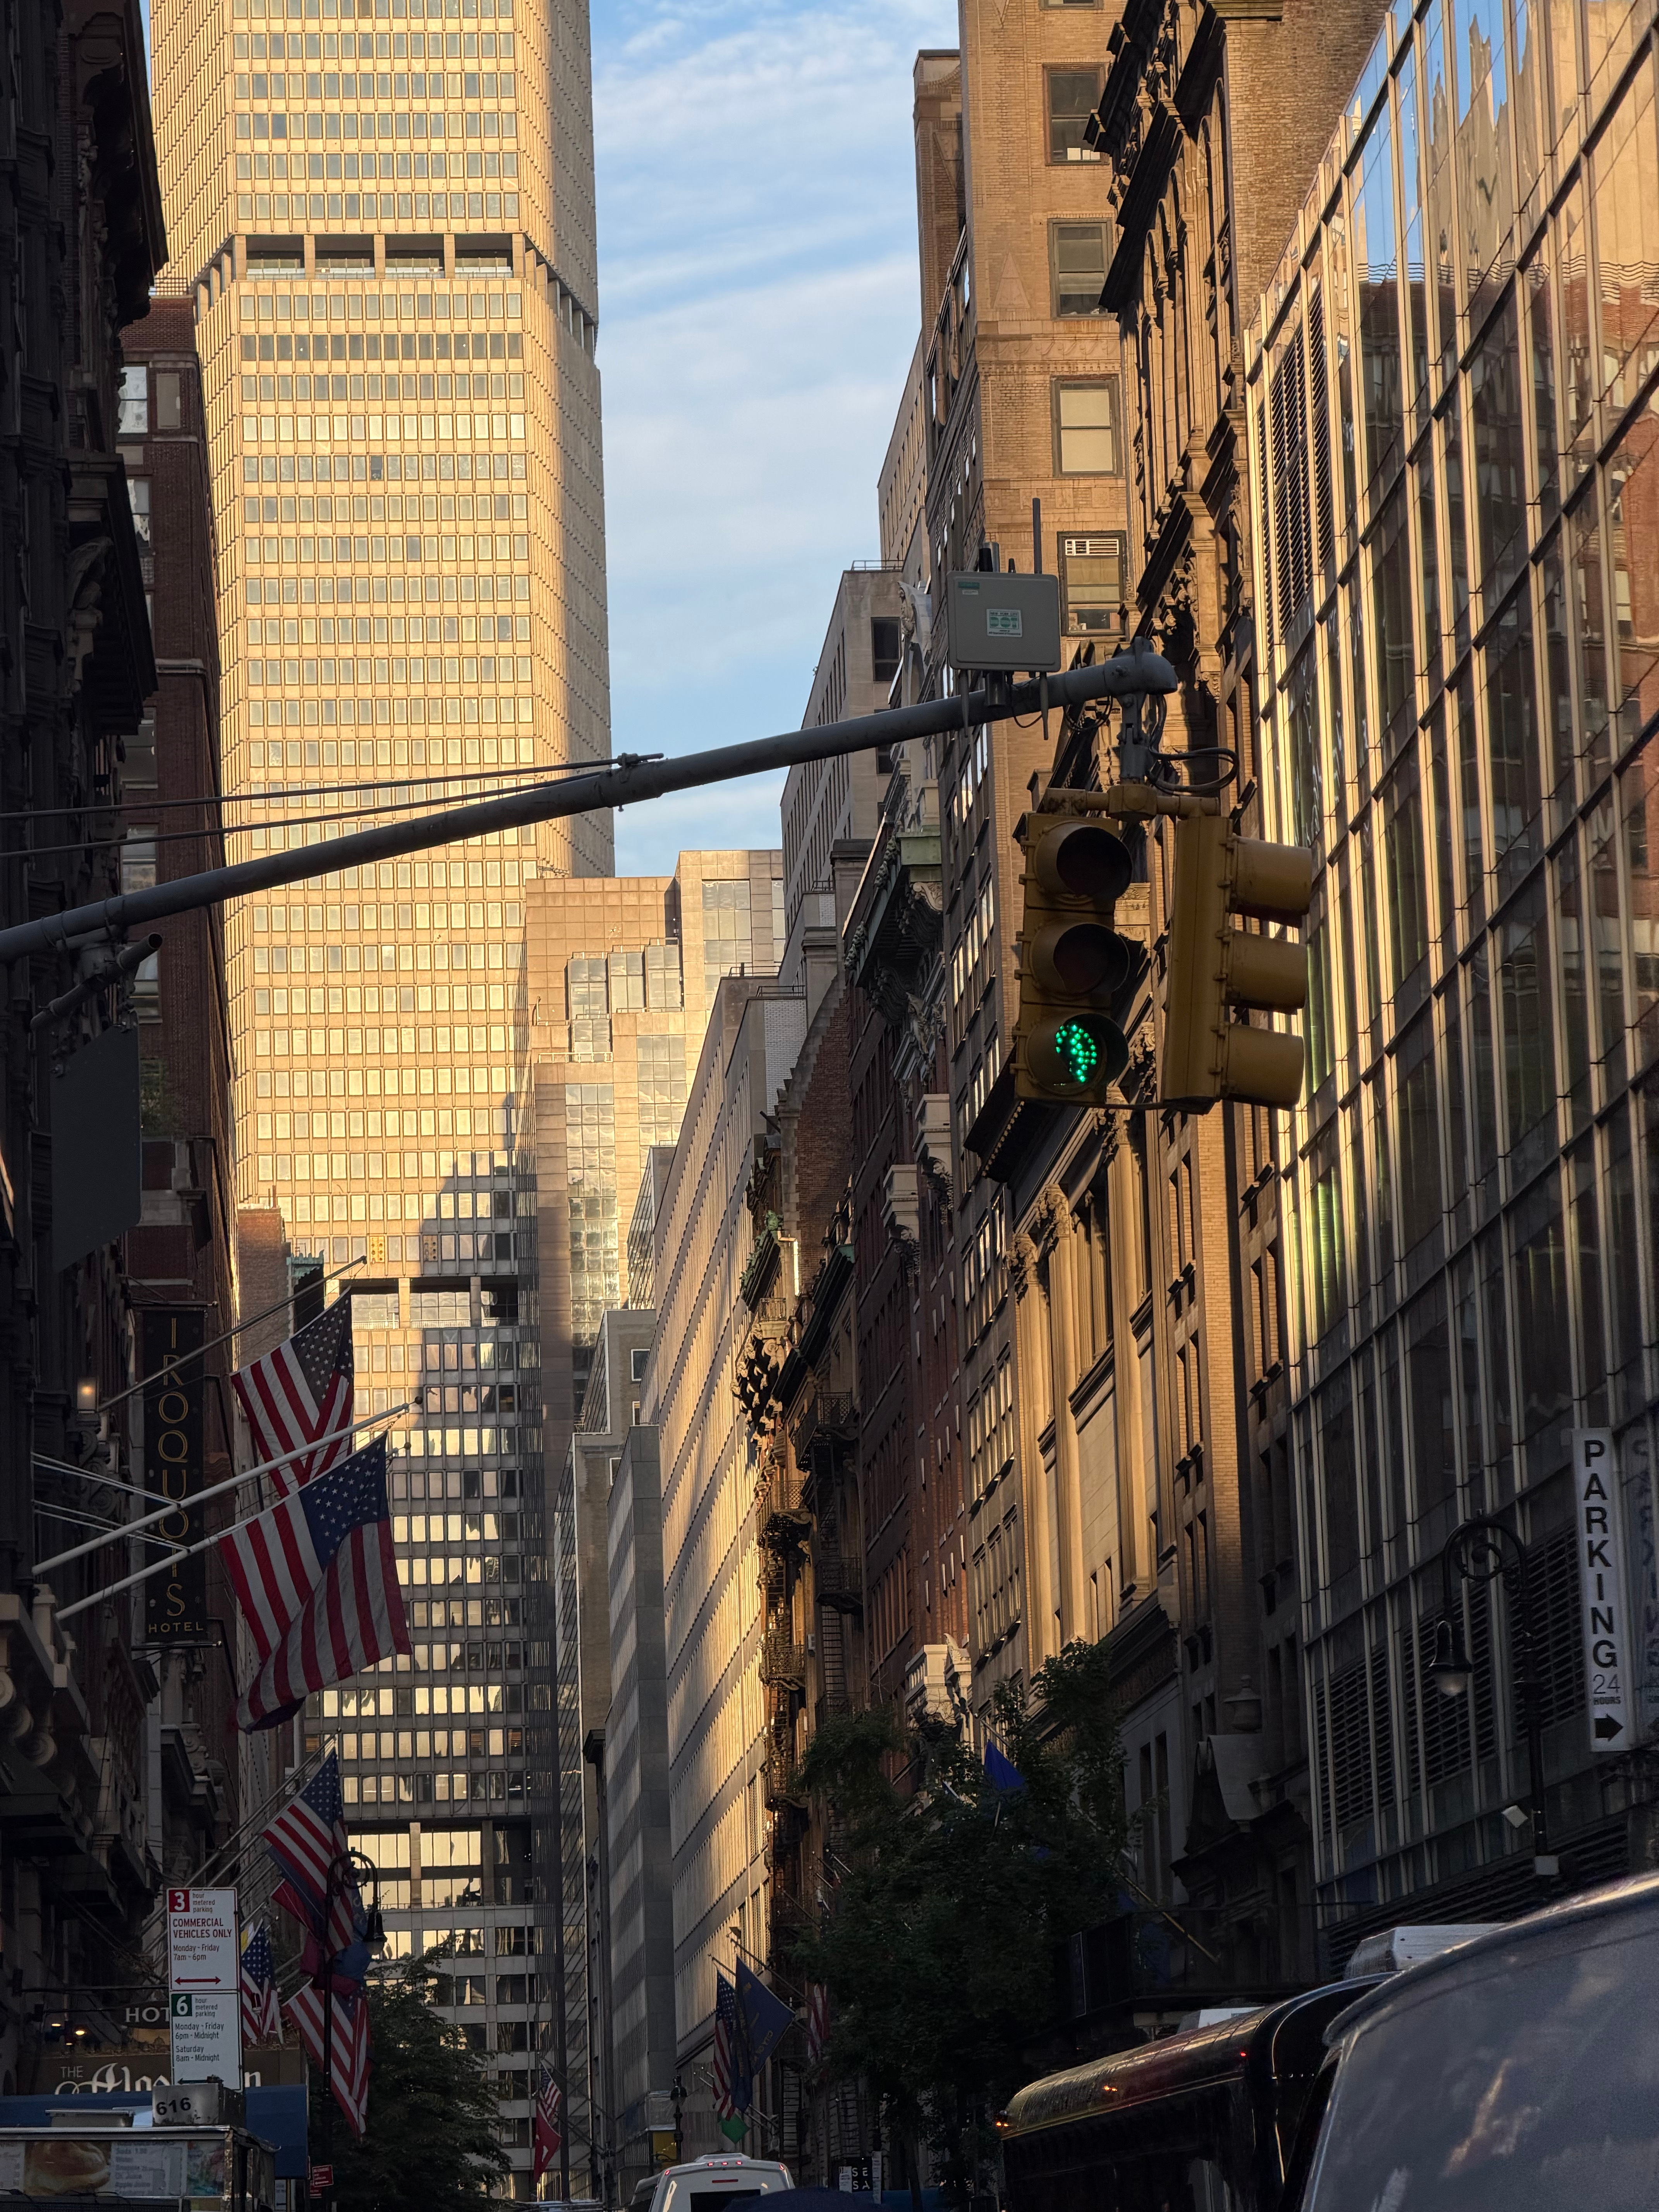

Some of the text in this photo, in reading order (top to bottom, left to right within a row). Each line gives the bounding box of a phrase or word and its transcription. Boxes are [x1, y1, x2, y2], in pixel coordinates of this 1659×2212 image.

[1583, 1439, 1618, 1668] PARKING
[149, 1621, 203, 1634] HOTEL
[1593, 1674, 1620, 1694] 24
[174, 1891, 185, 1911] 3
[173, 1918, 223, 1927] COMMERCIAL
[173, 1929, 232, 1938] VEHICLES ONLY
[202, 1944, 220, 1952] Friday
[176, 1996, 188, 2015] 6
[205, 2022, 224, 2031] Friday
[194, 2032, 219, 2040] Midnight
[195, 2054, 220, 2062] Midnight
[60, 2066, 84, 2078] THE
[156, 2097, 192, 2115] 616
